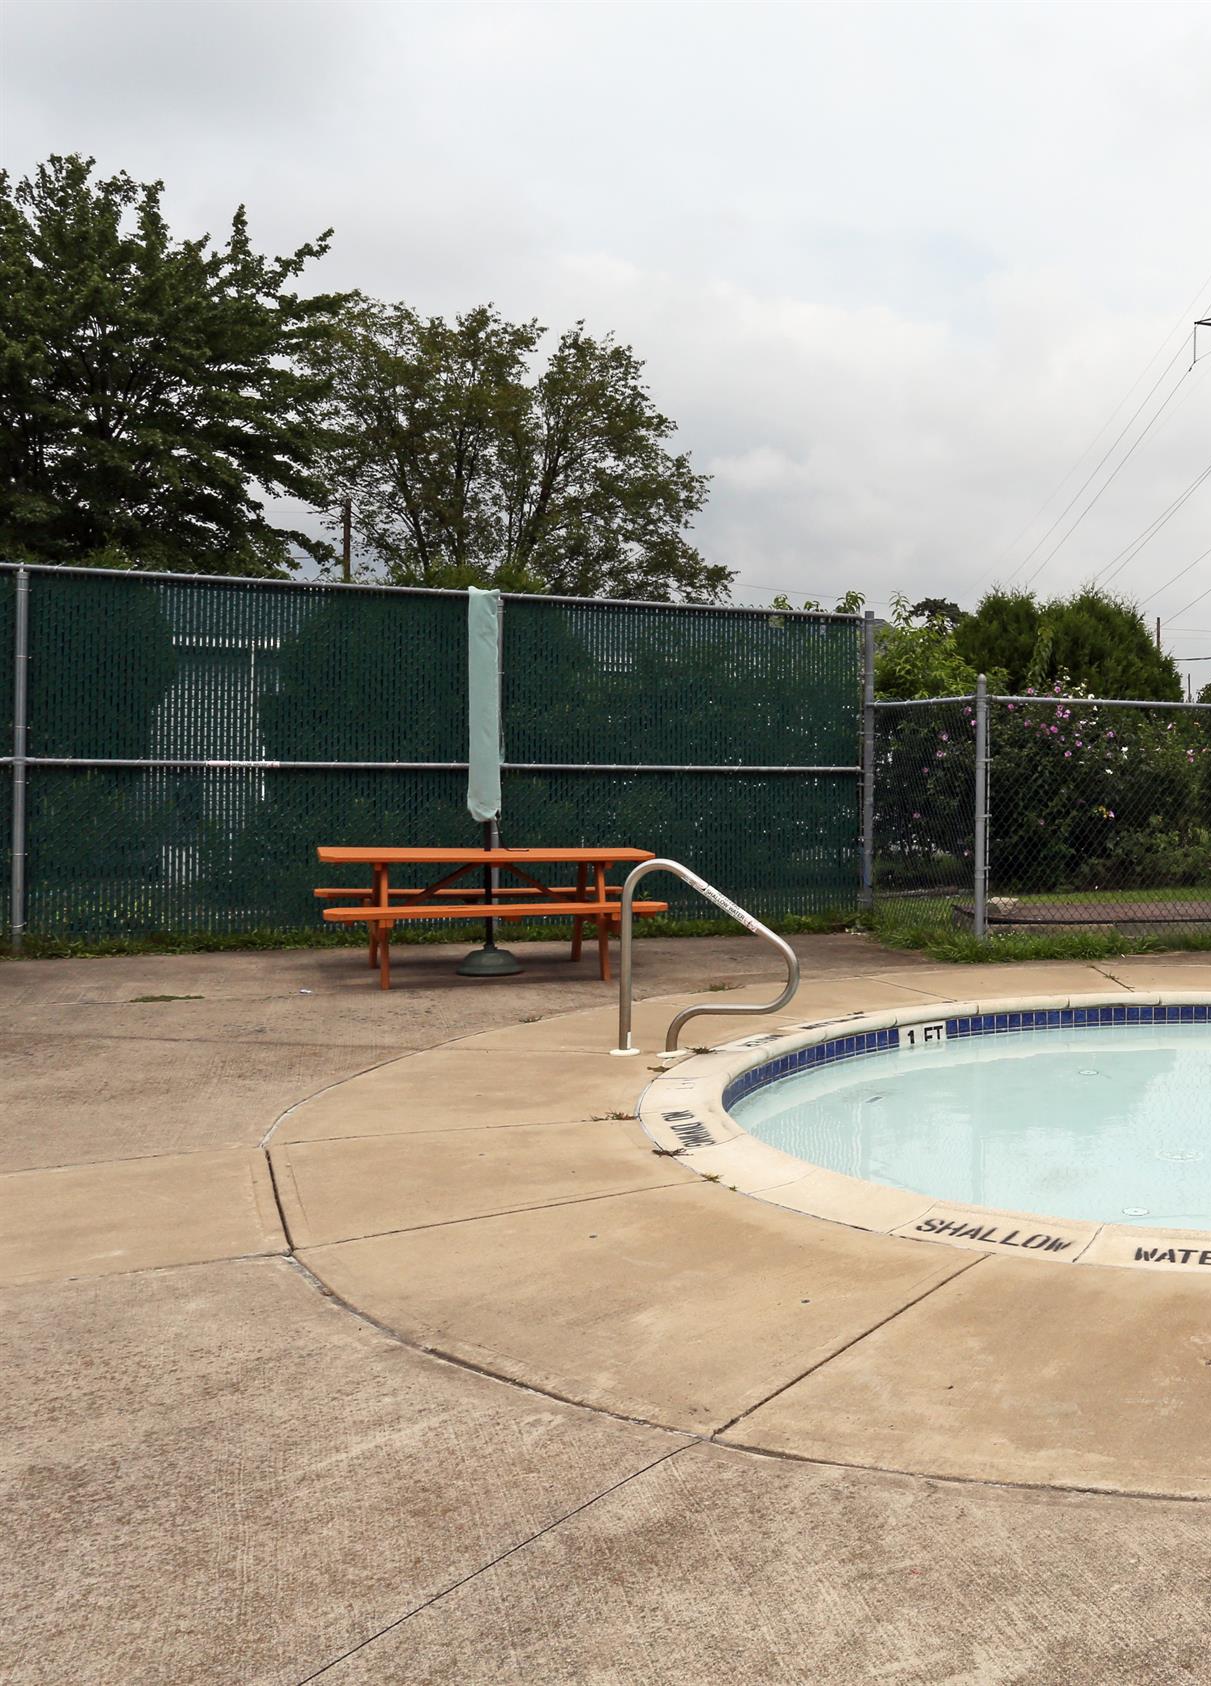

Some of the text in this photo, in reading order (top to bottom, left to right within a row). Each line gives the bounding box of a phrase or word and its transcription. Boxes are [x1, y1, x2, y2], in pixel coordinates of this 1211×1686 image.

[729, 905, 745, 920] WATER
[907, 1025, 943, 1044] 1 FT
[660, 1109, 695, 1121] NO
[916, 1218, 1070, 1252] SHALLOW
